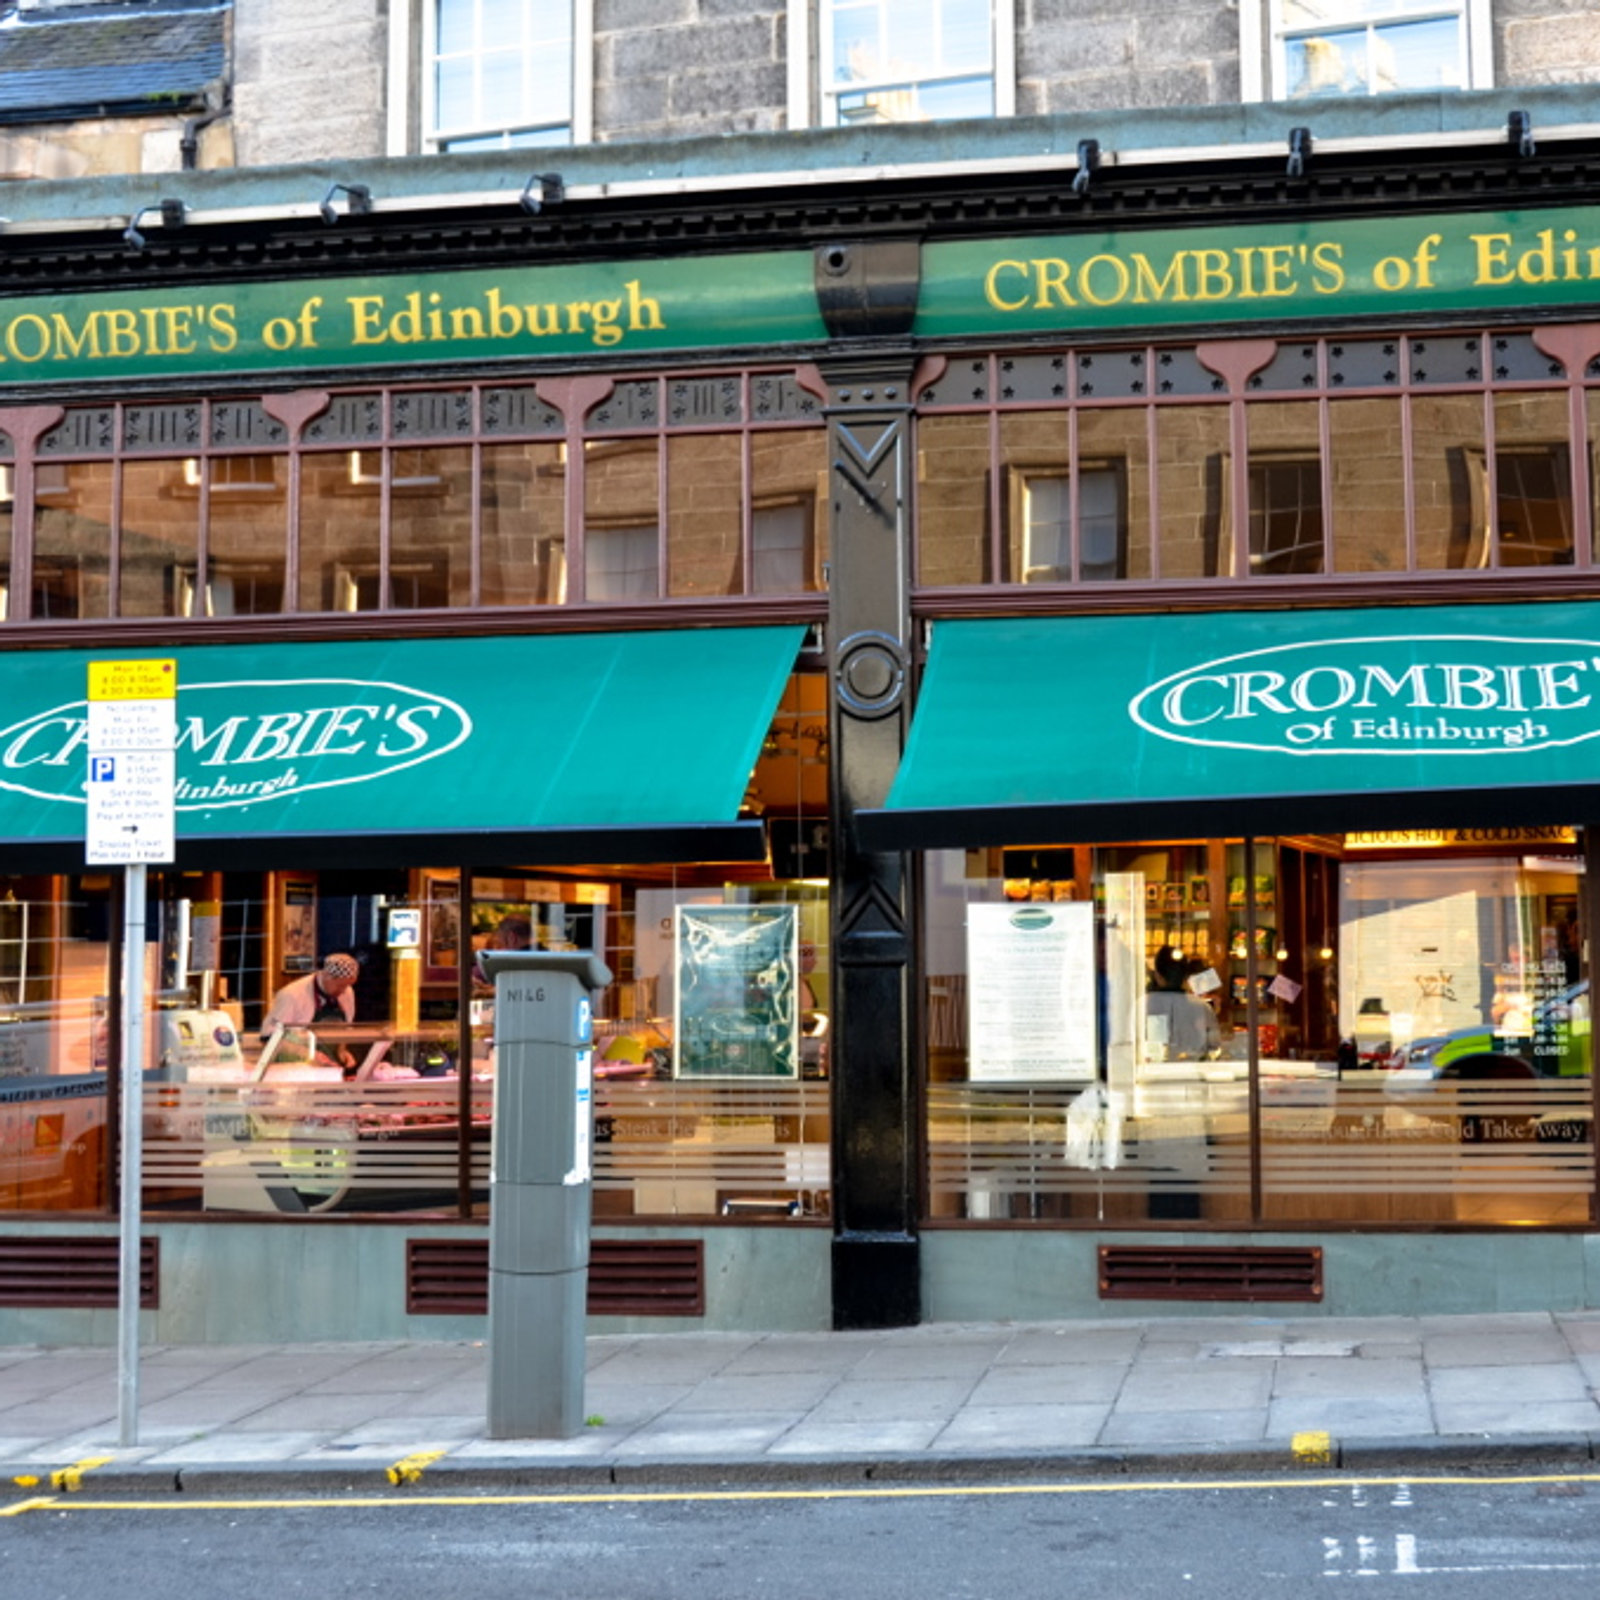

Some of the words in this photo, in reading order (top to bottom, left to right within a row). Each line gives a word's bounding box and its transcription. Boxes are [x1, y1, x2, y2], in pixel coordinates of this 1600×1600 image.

[984, 242, 1345, 311] CROMBIE'S
[1373, 233, 1443, 291] of
[0, 303, 238, 363] OMBIE'S
[262, 296, 323, 350] of
[347, 279, 667, 347] Edinburgh
[3, 704, 442, 768] CMBIE'S
[1351, 717, 1549, 745] Edinburgh
[1522, 824, 1575, 840] SNAC
[1480, 1116, 1525, 1138] Take
[1529, 1117, 1583, 1141] Away
